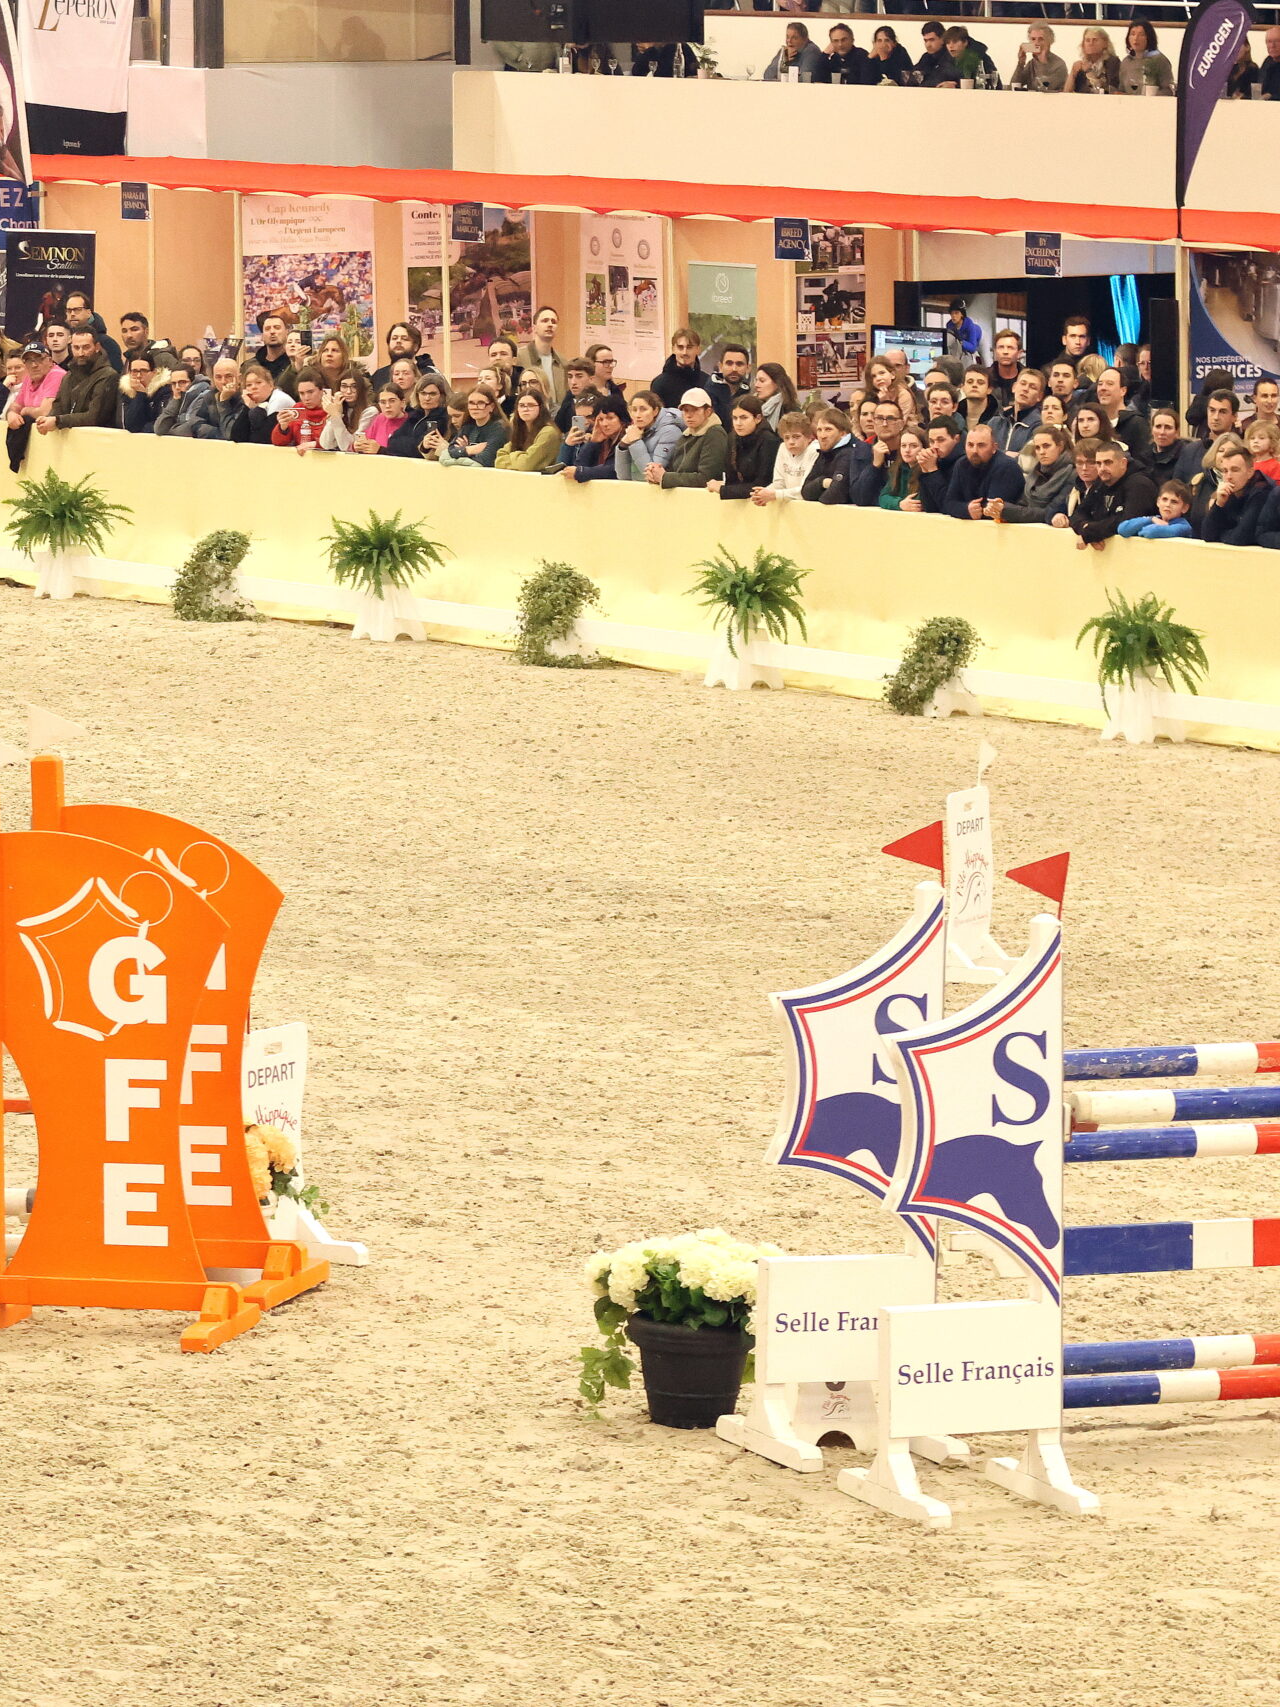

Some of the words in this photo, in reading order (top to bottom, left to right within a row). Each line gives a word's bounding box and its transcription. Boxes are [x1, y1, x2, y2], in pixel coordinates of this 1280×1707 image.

[1197, 18, 1235, 77] EUROGEN
[778, 239, 807, 249] AGENCY
[1025, 246, 1061, 257] EXCELLENCE
[1195, 356, 1211, 364] NOS
[957, 817, 984, 836] DEPART
[248, 1061, 296, 1088] DEPART
[992, 1030, 1051, 1128] S
[775, 1312, 830, 1333] Selle
[897, 1363, 955, 1386] Selle
[961, 1356, 1055, 1385] Français
